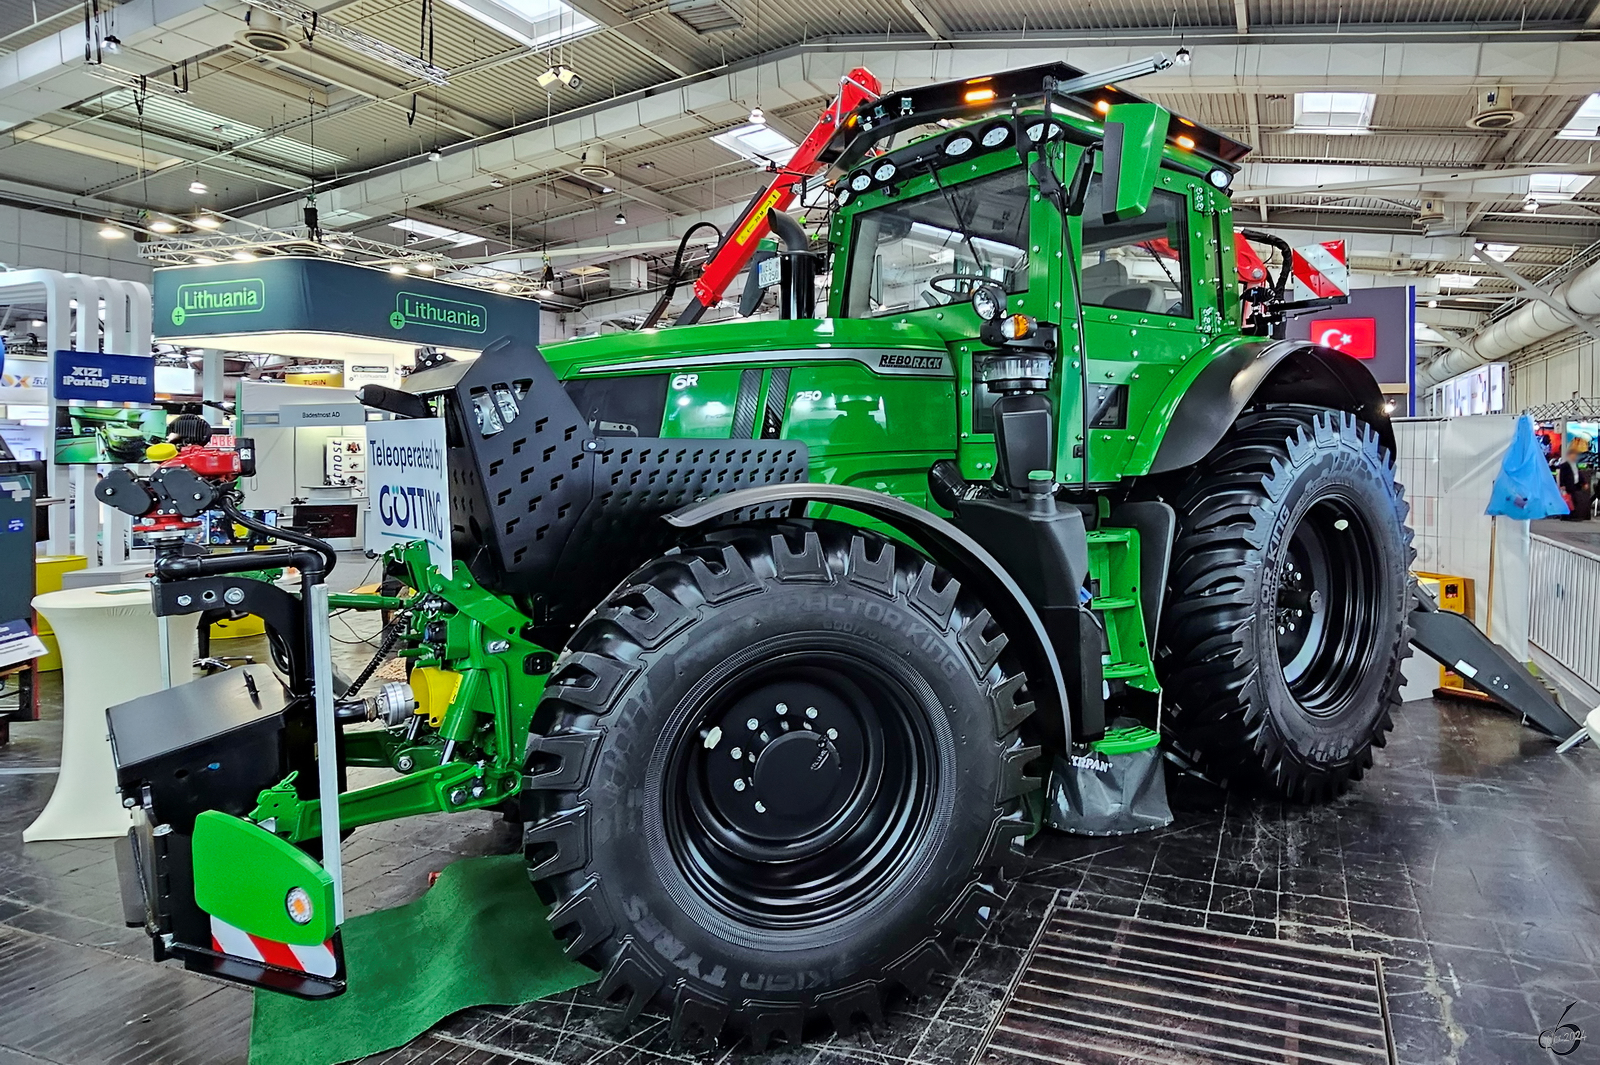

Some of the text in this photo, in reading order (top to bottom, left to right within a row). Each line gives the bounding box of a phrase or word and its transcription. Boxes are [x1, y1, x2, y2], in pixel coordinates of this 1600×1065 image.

[184, 287, 257, 310] Lithuania
[405, 299, 481, 327] Lithuania
[63, 375, 110, 388] iParking
[71, 367, 103, 377] XIZI
[671, 374, 698, 390] 6R
[796, 391, 822, 402] 250
[370, 439, 443, 479] Teleoperated by
[379, 485, 443, 540] GÖTTING
